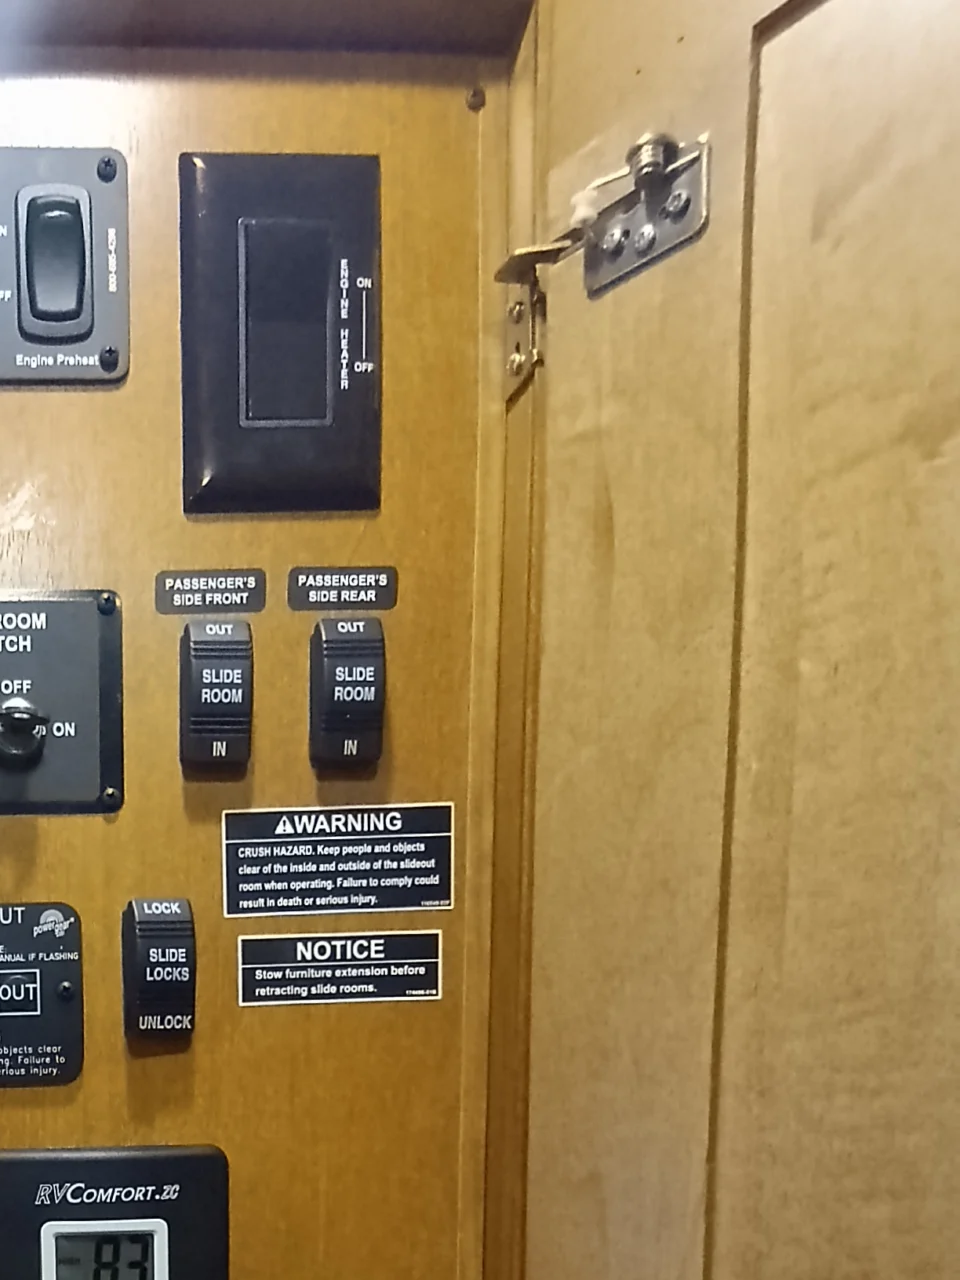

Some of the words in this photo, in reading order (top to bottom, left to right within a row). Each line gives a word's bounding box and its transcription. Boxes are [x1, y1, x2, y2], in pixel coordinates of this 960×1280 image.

[340, 258, 349, 319] ENGINE
[356, 277, 372, 288] ON
[16, 354, 54, 370] Engine
[57, 354, 100, 367] Preheat
[340, 329, 349, 390] HEATER
[354, 361, 374, 373] OFF
[165, 577, 256, 590] PASSENGER'S
[297, 574, 388, 586] PASSENGER'S
[173, 594, 203, 605] SIDE
[205, 592, 249, 605] FRONT
[308, 591, 338, 602] SIDE
[341, 590, 376, 601] REAR
[205, 624, 234, 635] OUT
[337, 621, 366, 633] OUT
[202, 669, 242, 683] SLIDE
[335, 667, 375, 681] SLIDE
[1, 681, 32, 694] OFF
[334, 686, 376, 701] ROOM
[201, 688, 243, 703] ROOM
[53, 722, 76, 737] ON
[212, 741, 227, 757] IN
[343, 740, 358, 755] IN
[293, 812, 402, 834] WARNING
[238, 847, 271, 858] CRUSH
[273, 845, 315, 856] HAZARD.
[317, 844, 340, 856] Keep
[342, 843, 371, 856] people
[374, 842, 390, 853] and
[392, 842, 425, 854] objects
[238, 864, 260, 875] clear
[262, 863, 272, 873] of
[273, 863, 288, 873] the
[289, 862, 317, 872] inside
[318, 861, 336, 871] and
[337, 861, 371, 871] outside
[372, 859, 382, 869] of
[383, 859, 398, 869] the
[400, 858, 435, 868] slideout
[239, 883, 262, 891] room
[264, 880, 288, 890] when
[289, 879, 335, 891] operating.
[336, 877, 367, 887] Failure
[369, 877, 378, 886] to
[380, 875, 413, 888] comply
[414, 874, 440, 884] could
[239, 898, 264, 908] result
[266, 898, 275, 907] in
[277, 896, 302, 906] death
[304, 897, 314, 905] or
[315, 895, 349, 904] serious
[350, 893, 378, 906] injury.
[144, 902, 181, 914] LOCK
[28, 953, 36, 961] IF
[38, 952, 79, 961] FLASHING
[149, 949, 186, 962] SLIDE
[296, 939, 385, 961] NOTICE
[147, 967, 189, 981] LOCKS
[255, 969, 282, 980] Stow
[285, 968, 332, 979] furniture
[335, 966, 388, 977] extension
[390, 965, 426, 975] before
[0, 984, 37, 1000] OUT
[255, 985, 308, 997] retracting
[311, 984, 337, 995] slide
[339, 984, 377, 994] rooms.
[139, 1015, 191, 1030] UNLOCK
[38, 1045, 62, 1053] clear
